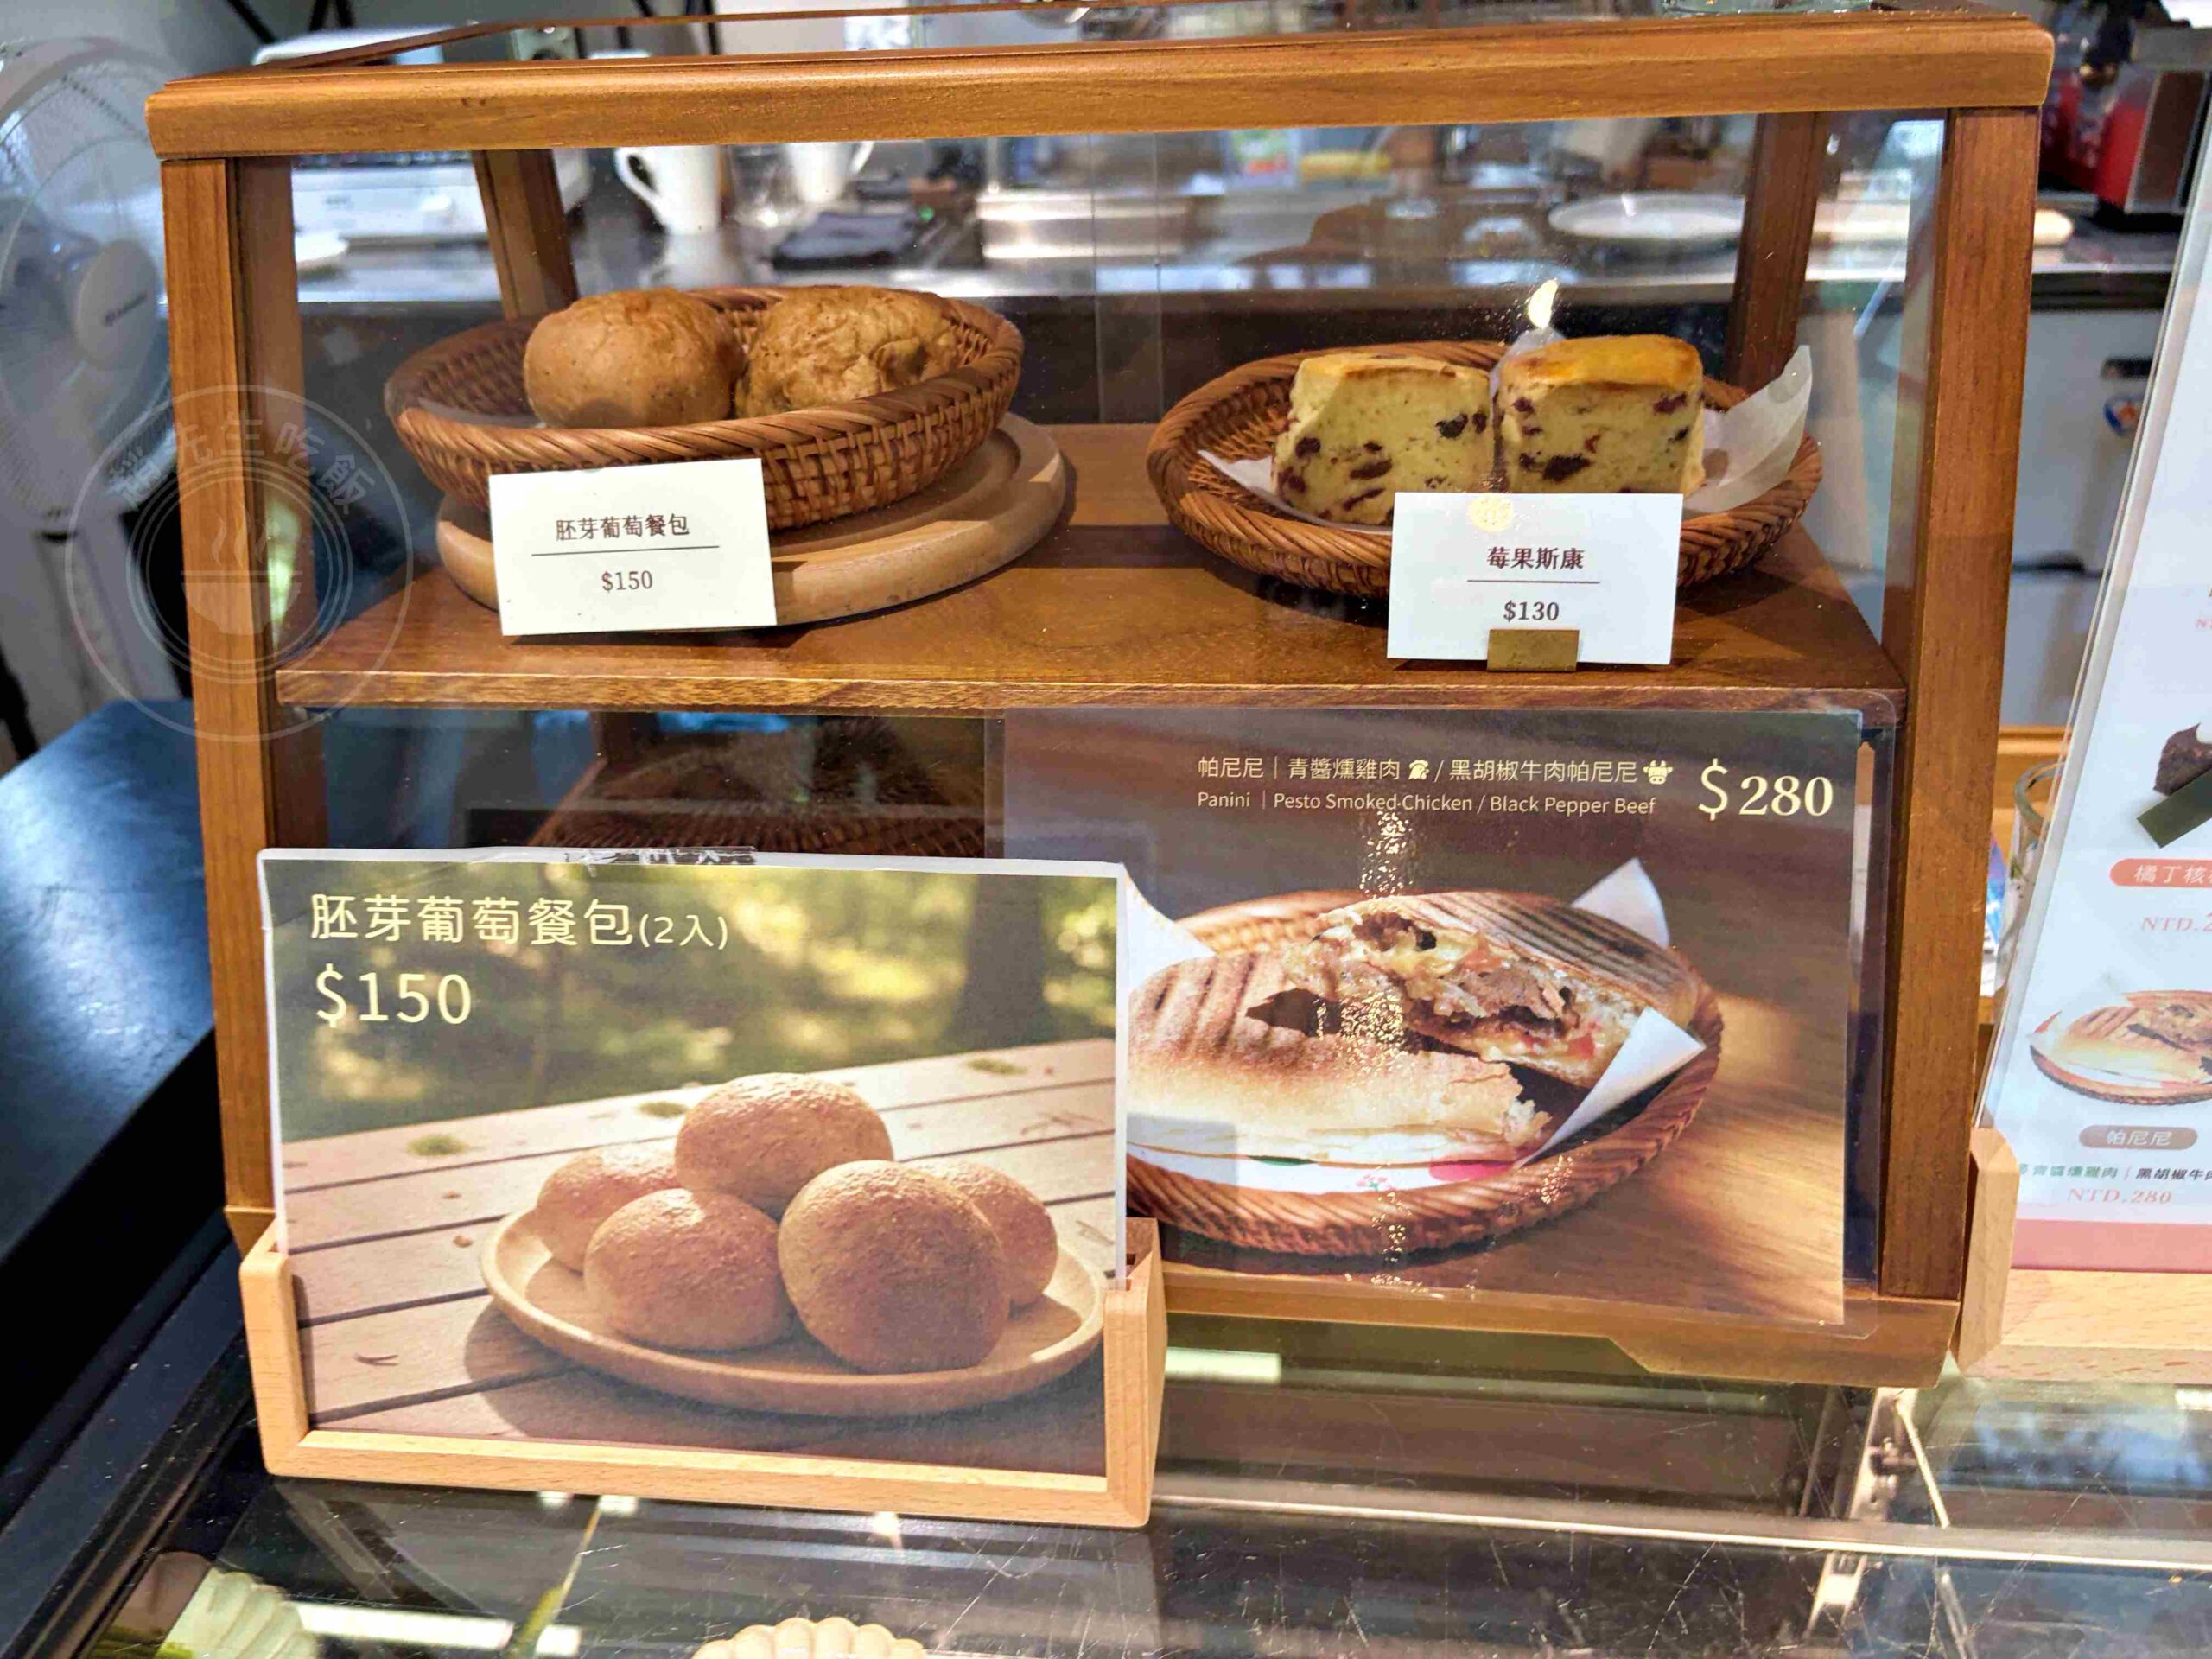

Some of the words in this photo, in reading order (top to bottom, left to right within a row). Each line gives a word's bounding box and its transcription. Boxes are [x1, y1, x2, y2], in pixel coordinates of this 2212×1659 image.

[555, 513, 690, 542] 胚芽葡萄餐包
[1486, 547, 1587, 570] 莓果斯康
[601, 570, 653, 594] $150
[1503, 600, 1560, 623] $130
[1198, 756, 1265, 779] 帕尼尼
[1287, 757, 1401, 780] 青醬燻雞肉
[1449, 758, 1638, 784] 黑胡椒牛肉帕尼尼
[1697, 758, 1834, 822] $280
[1198, 791, 1250, 809] Panini
[1274, 792, 1321, 810] Pesto
[1325, 793, 1399, 811] Smoked
[1402, 793, 1473, 812] Chicken
[1491, 795, 1540, 813] Black
[1545, 797, 1610, 817] Pepper
[1615, 797, 1656, 815] Beef
[2134, 864, 2212, 884] 橘丁核
[309, 893, 729, 950] 胚芽葡萄餐包(2入)
[315, 963, 474, 1028] $150
[2106, 1129, 2172, 1147] 帕尼尼
[2068, 1187, 2172, 1204] NTD.280
